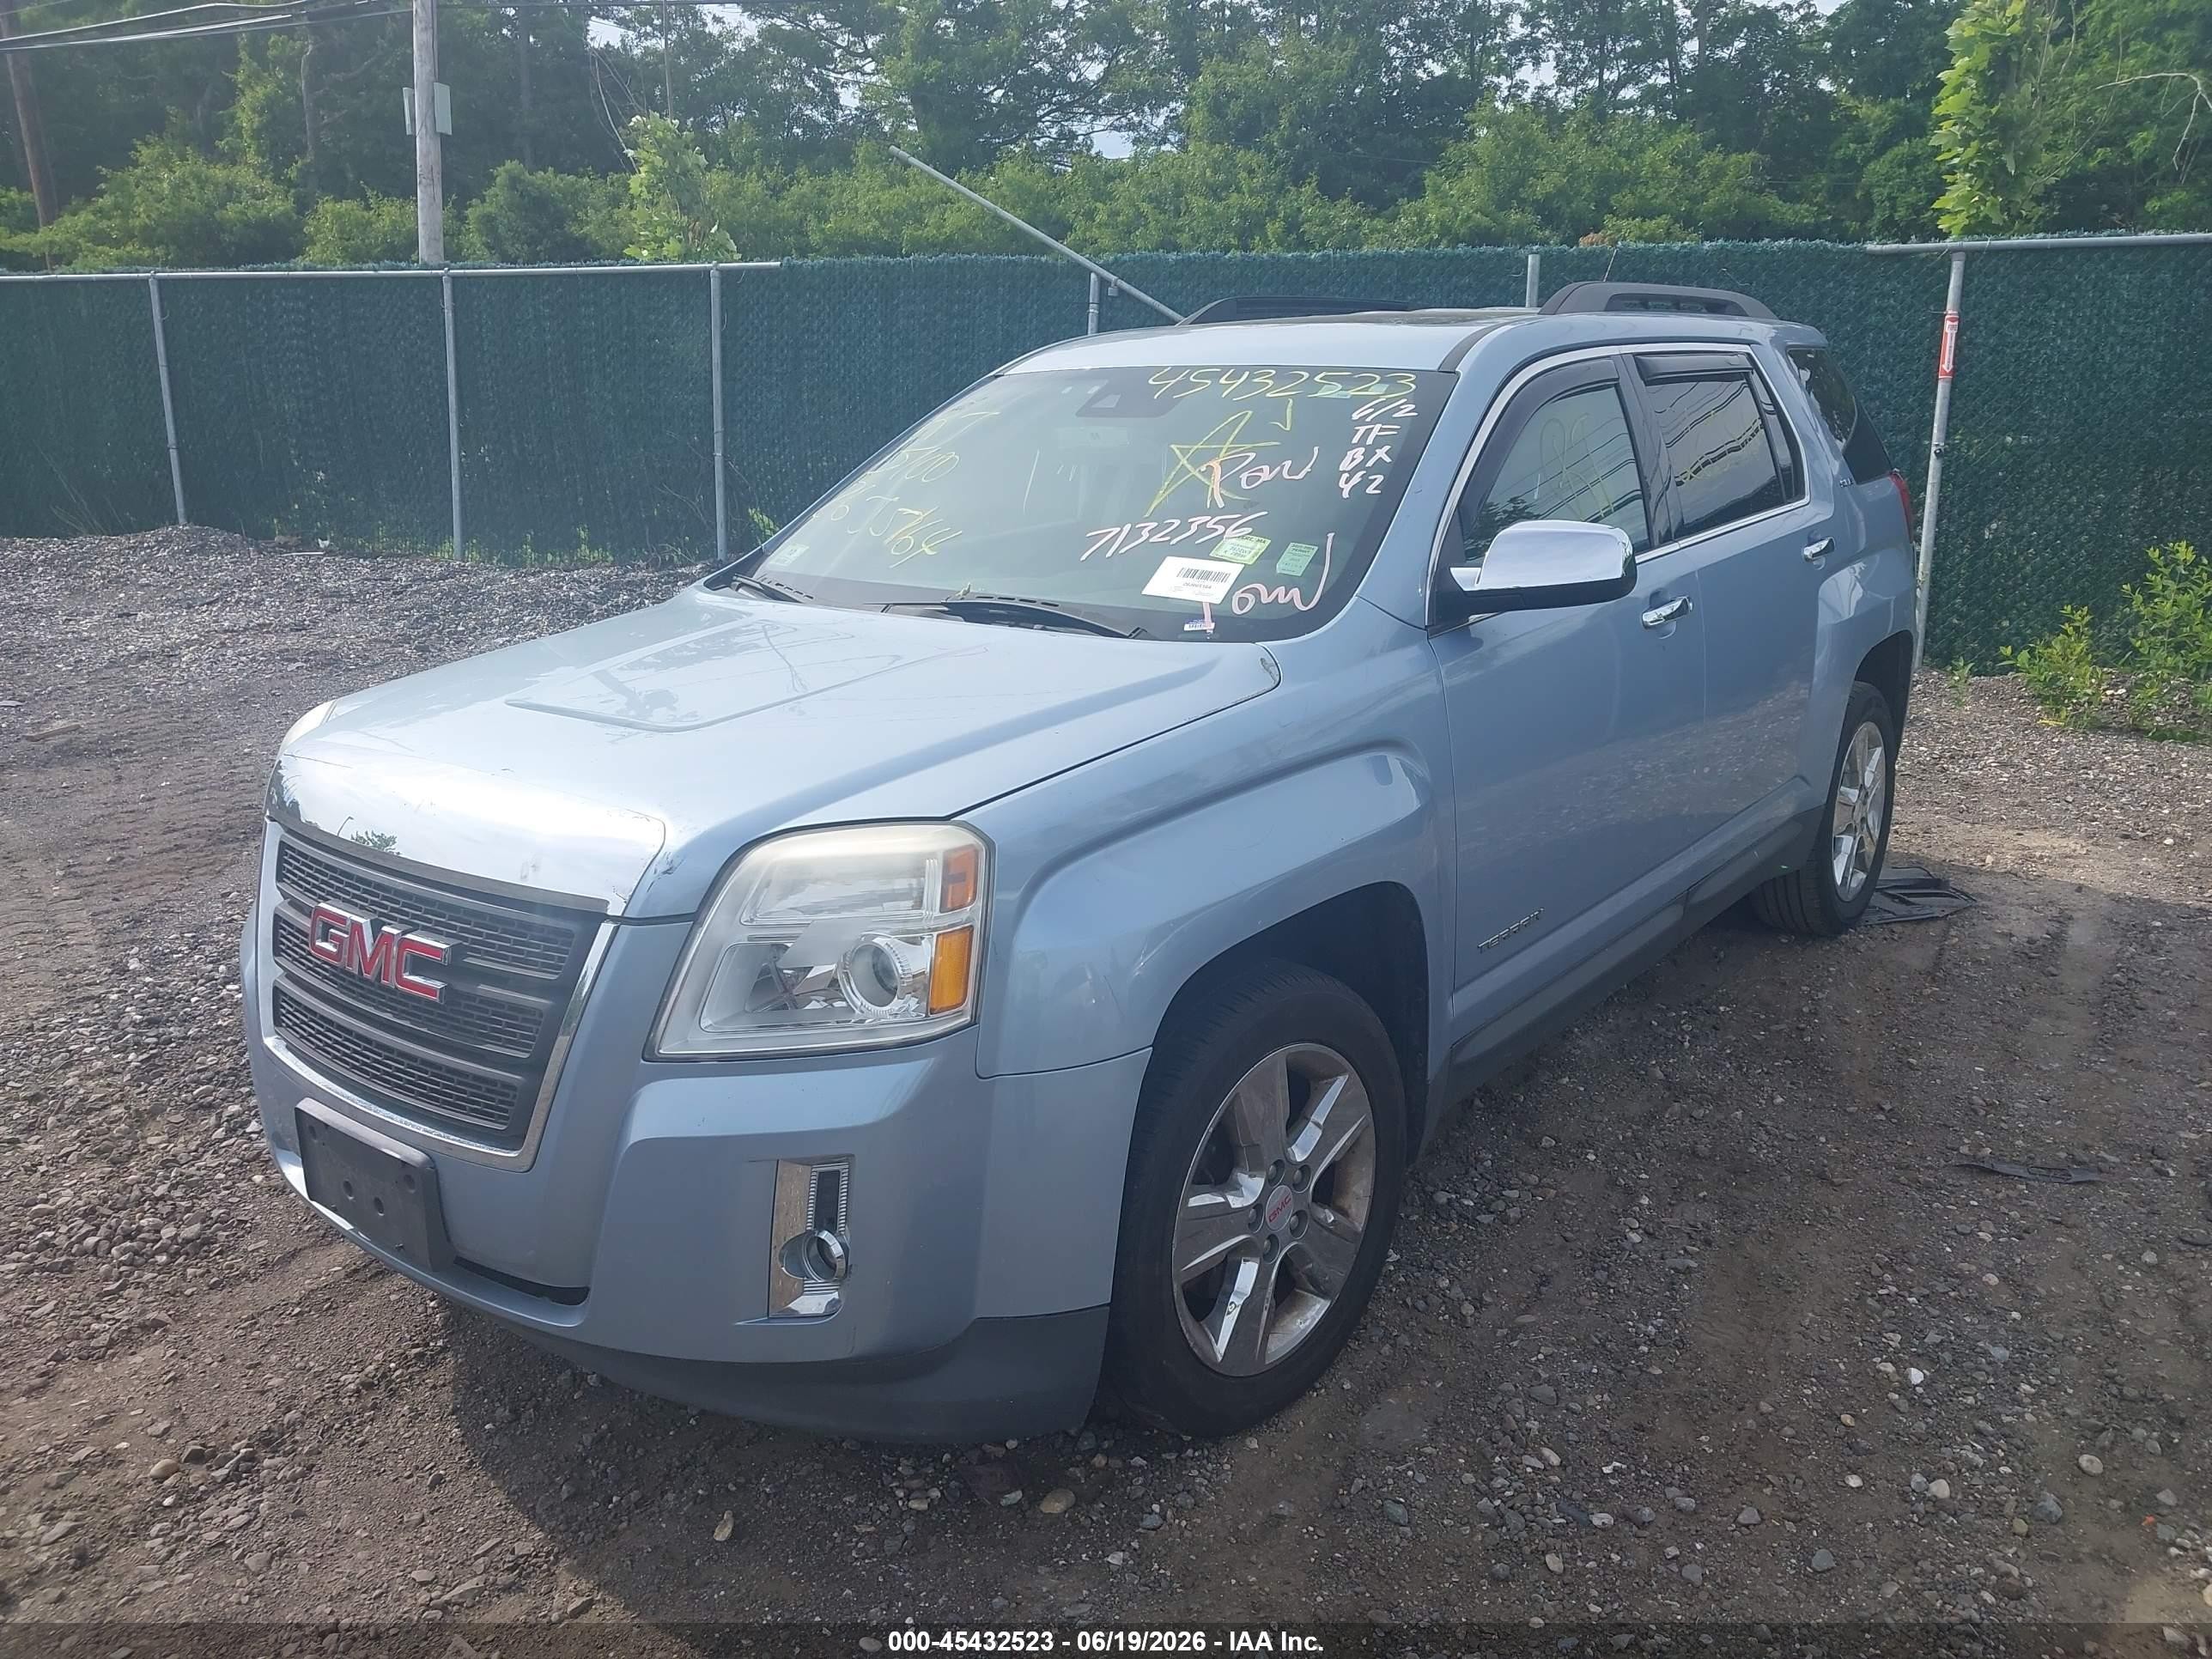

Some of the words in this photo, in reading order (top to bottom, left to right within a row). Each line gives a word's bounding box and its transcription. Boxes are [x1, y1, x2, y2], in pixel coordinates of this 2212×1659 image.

[1148, 366, 1417, 401] 45432523
[1351, 423, 1401, 446] TF
[1079, 511, 1269, 562] 7132356
[310, 902, 453, 1003] GMC
[1267, 1194, 1292, 1223] GMC
